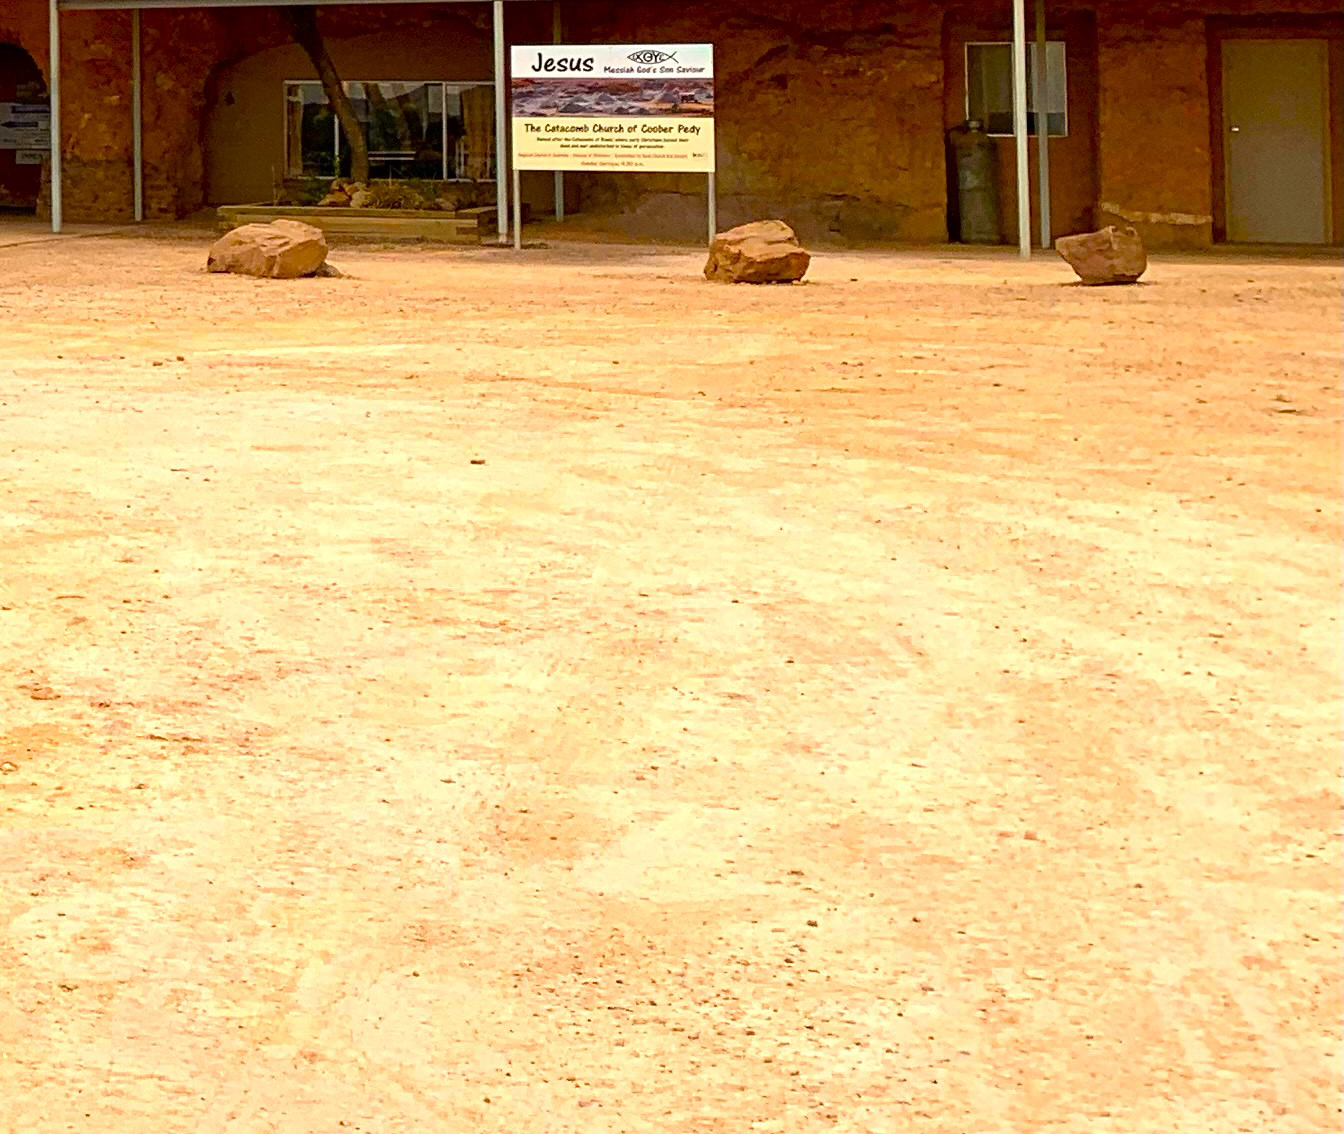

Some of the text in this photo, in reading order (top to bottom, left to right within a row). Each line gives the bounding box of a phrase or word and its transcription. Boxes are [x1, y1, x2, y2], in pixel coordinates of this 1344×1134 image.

[532, 52, 594, 72] Jesus
[524, 124, 701, 135] The Catacomb Church of Coober Pedy
